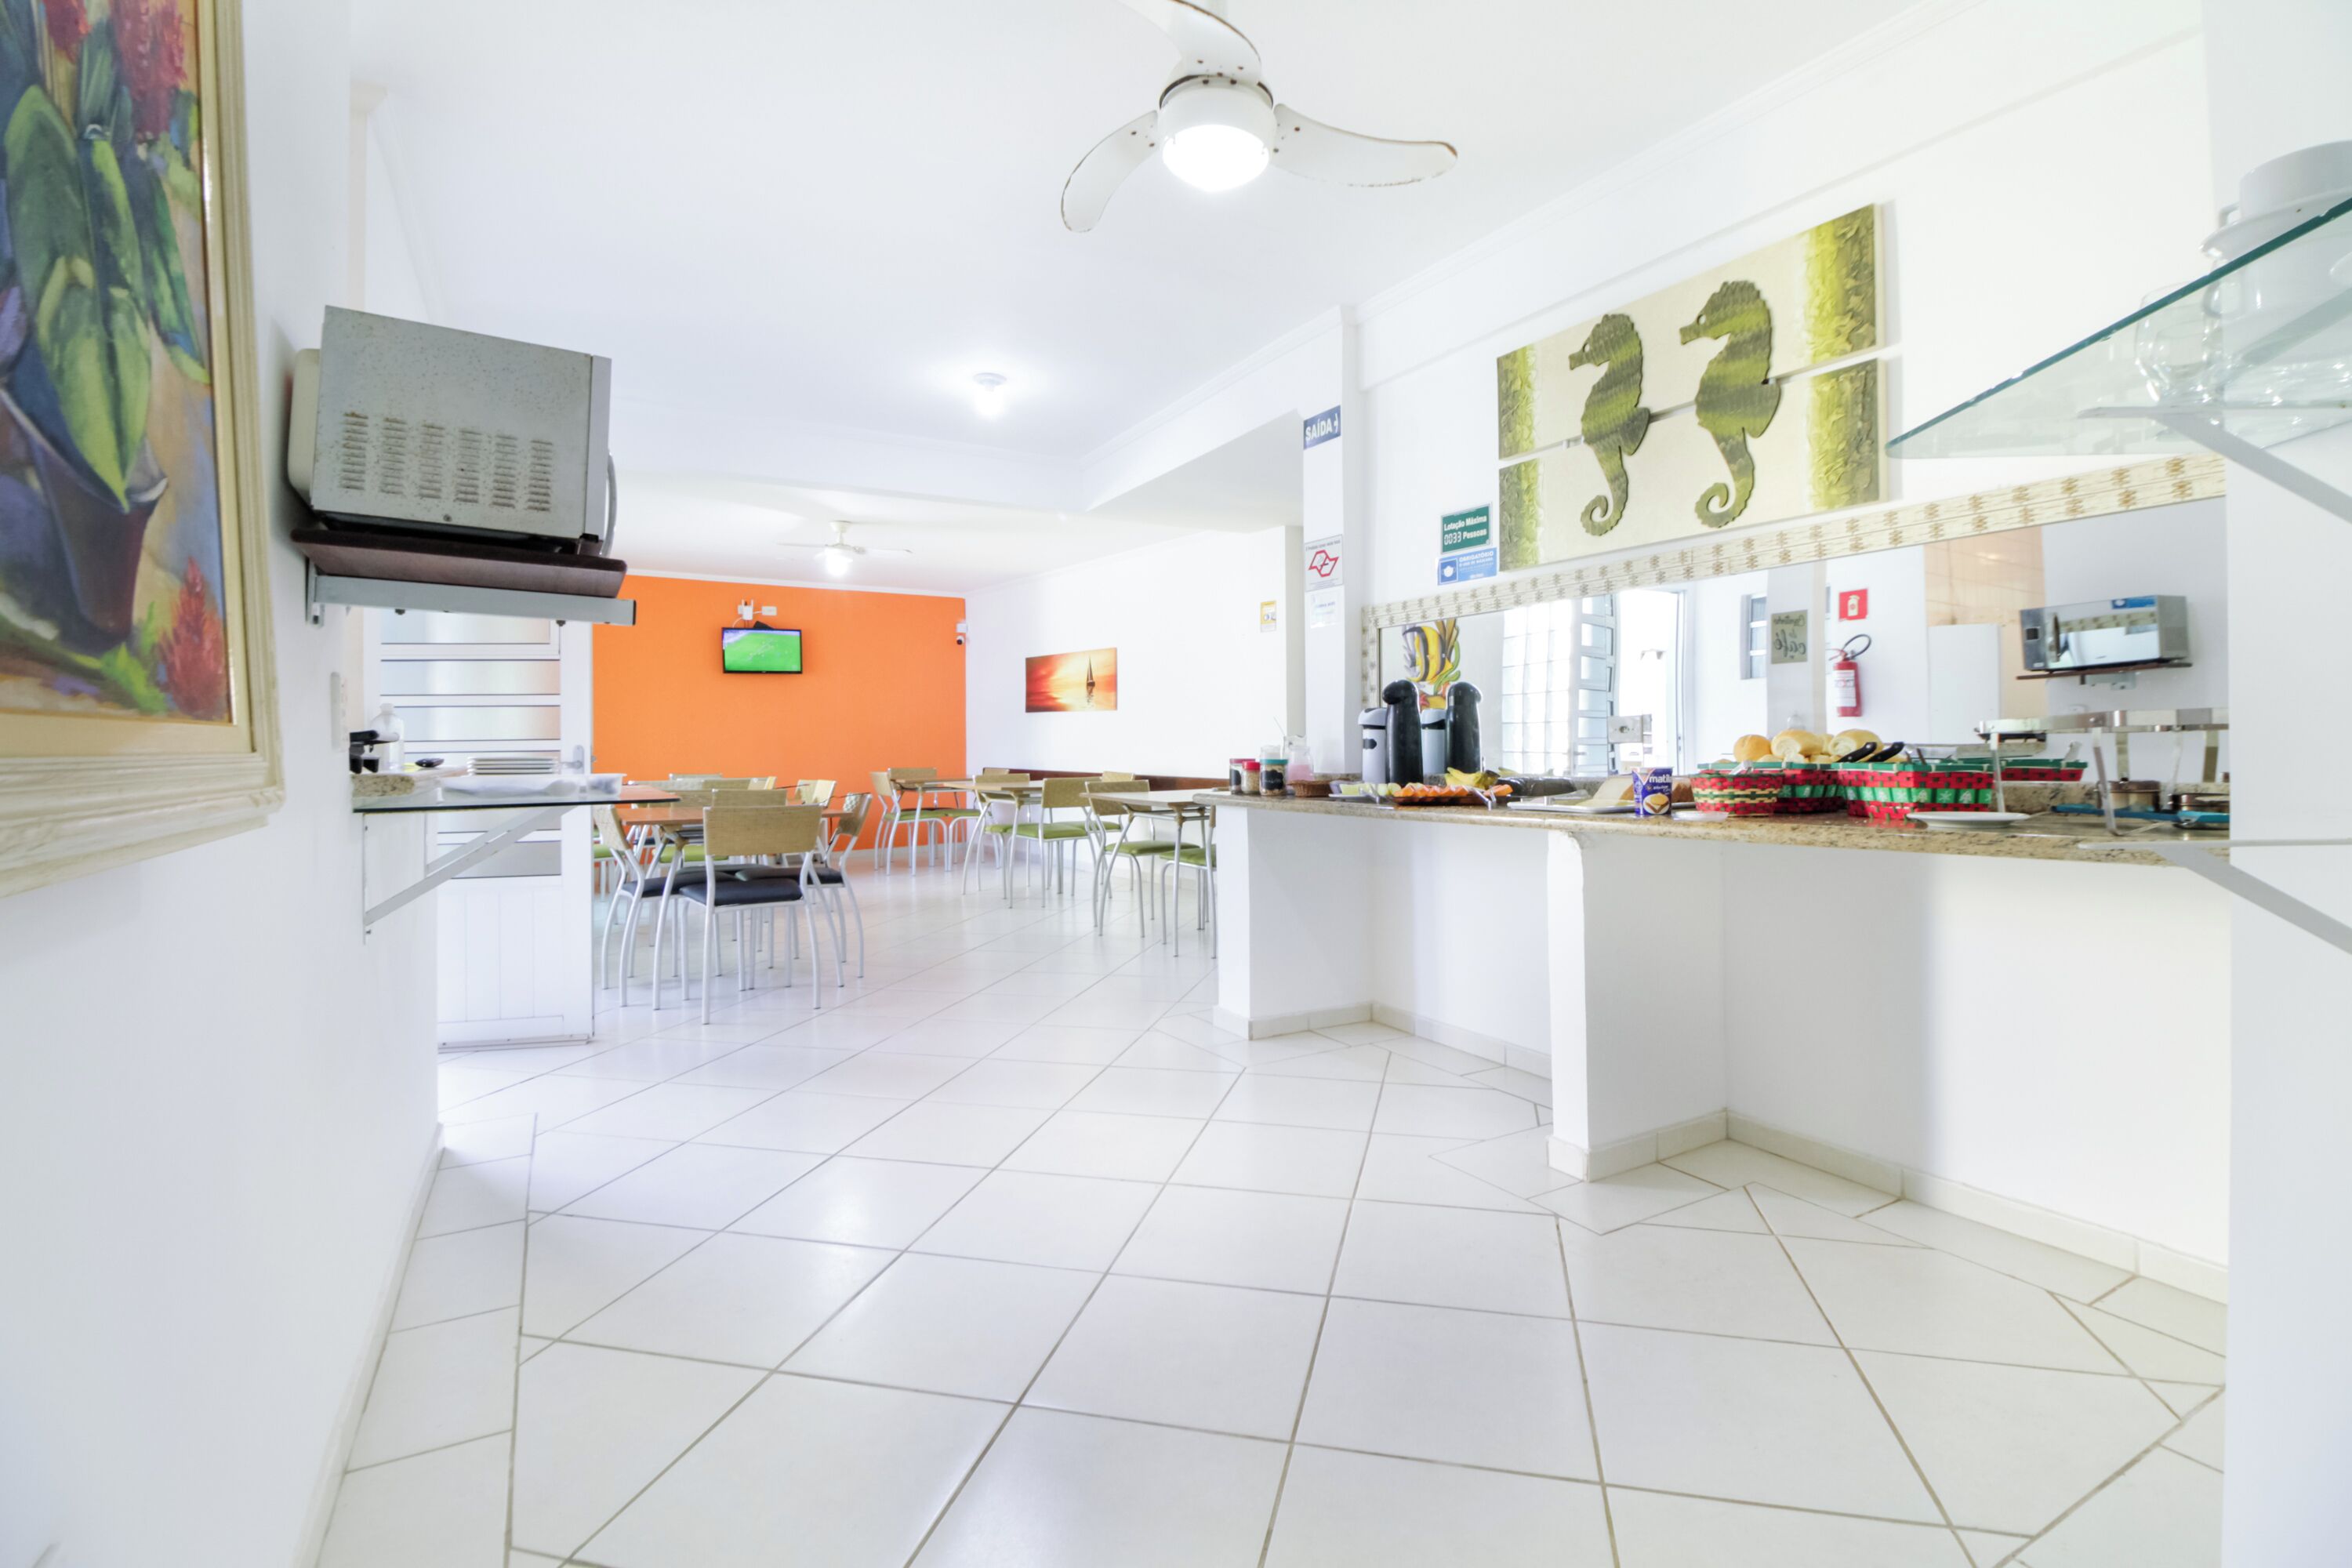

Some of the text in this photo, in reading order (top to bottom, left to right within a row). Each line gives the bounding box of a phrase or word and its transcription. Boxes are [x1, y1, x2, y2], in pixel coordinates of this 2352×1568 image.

[1305, 419, 1333, 441] SAÍDA
[1444, 515, 1486, 531] Lotação Máxima
[1444, 528, 1487, 546] 0033 Pessoas
